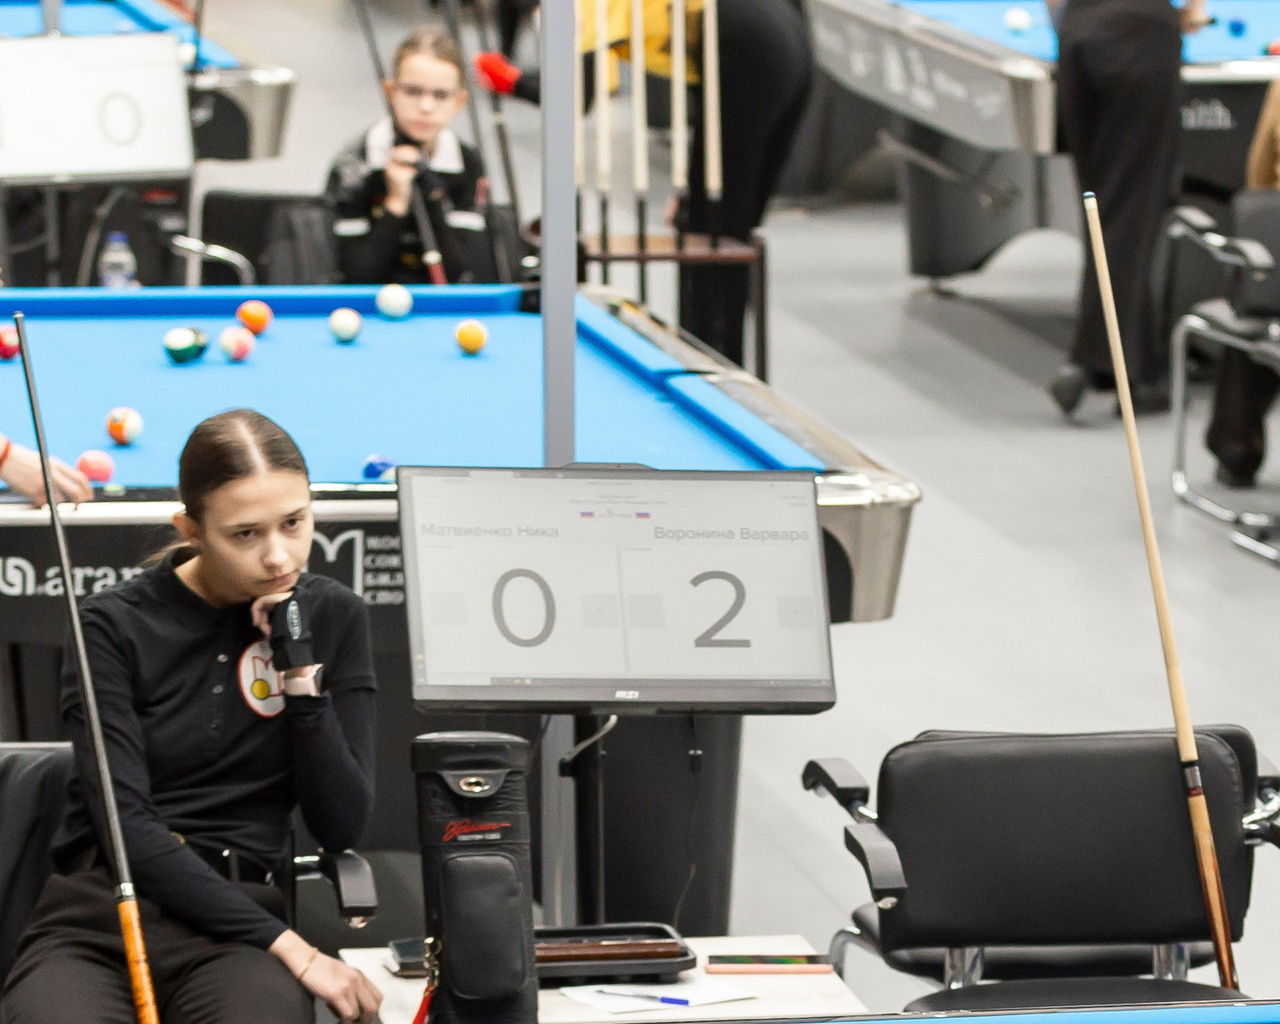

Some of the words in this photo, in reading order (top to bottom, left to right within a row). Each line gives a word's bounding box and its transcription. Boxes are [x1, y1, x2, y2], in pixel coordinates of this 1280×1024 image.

[654, 527, 735, 541] Воронина
[740, 528, 809, 542] Варвара
[492, 568, 556, 647] 0
[690, 571, 752, 648] 2
